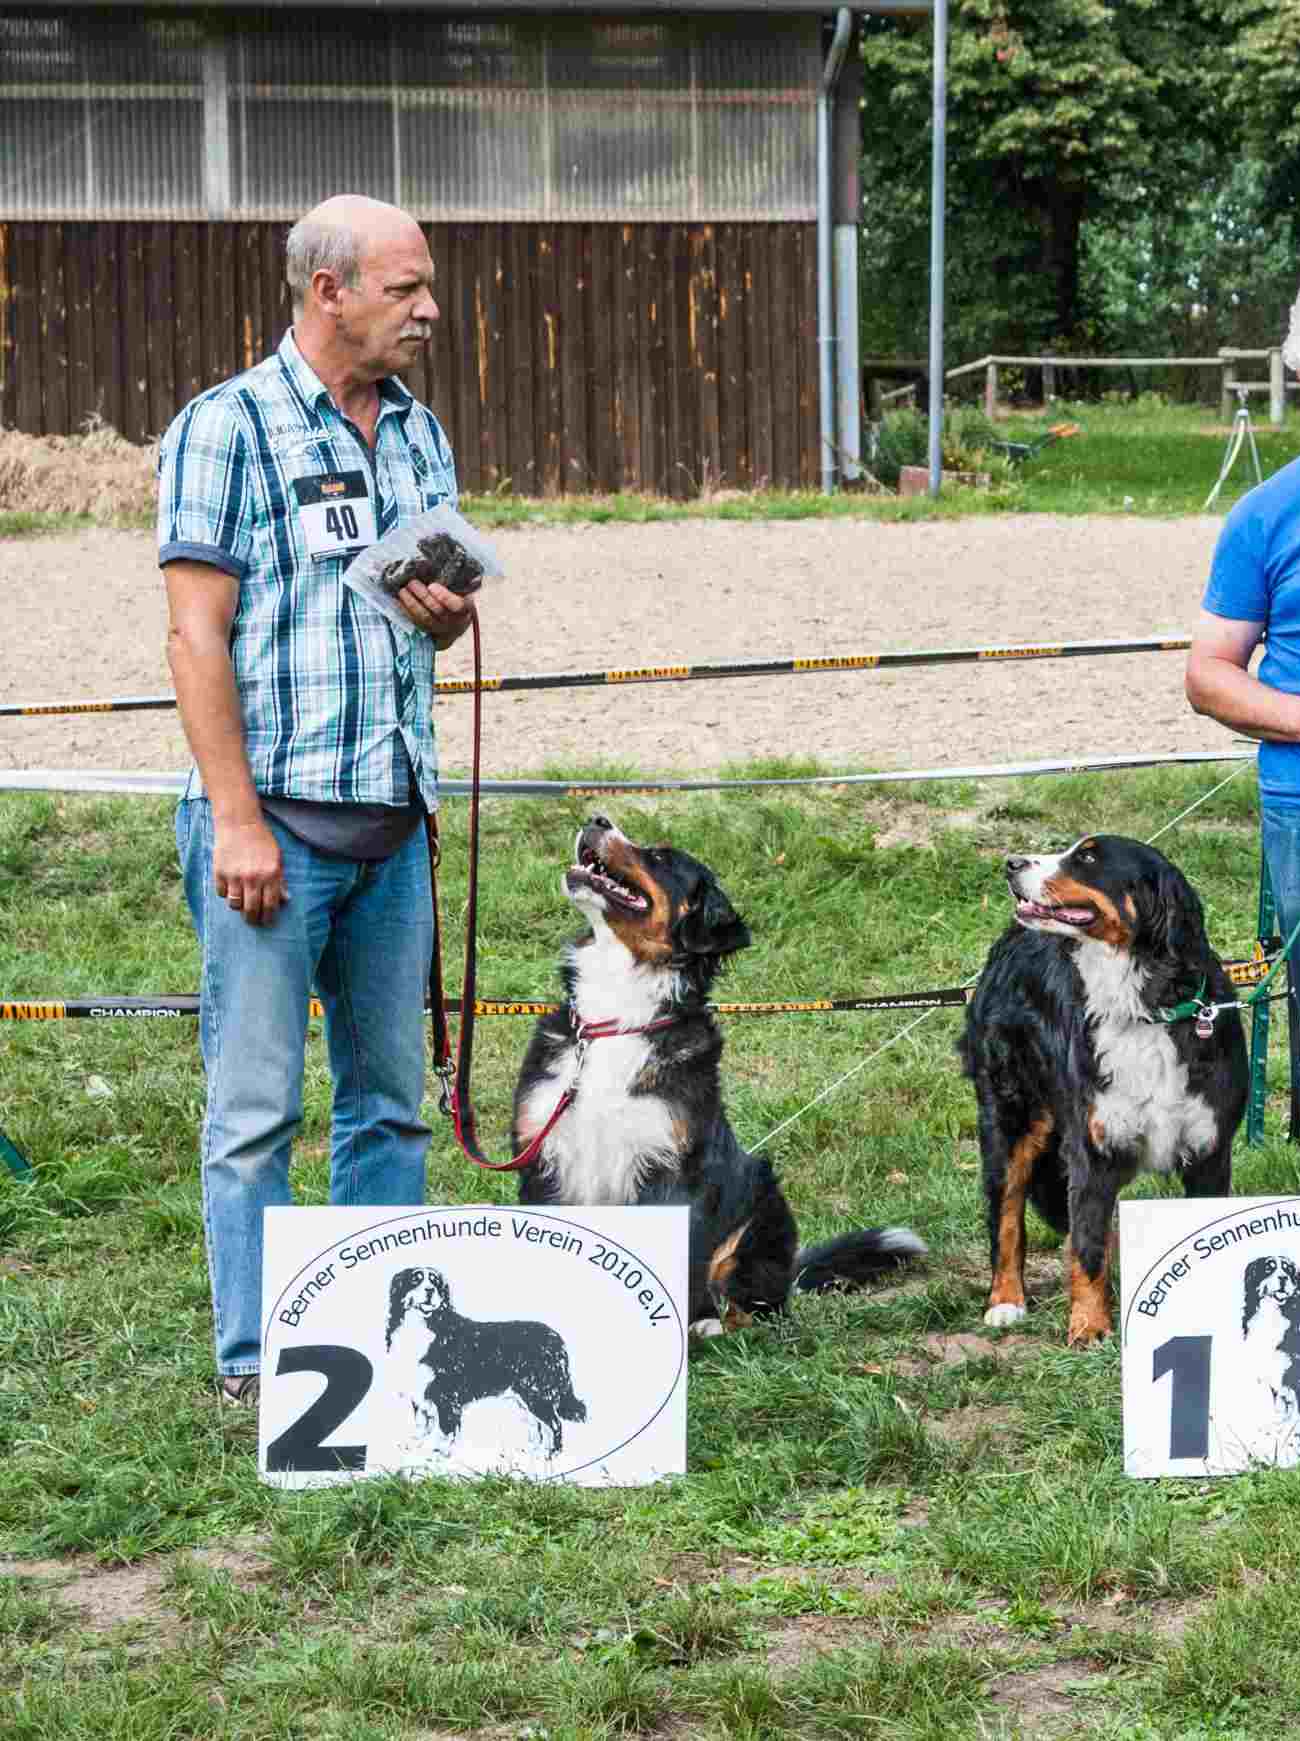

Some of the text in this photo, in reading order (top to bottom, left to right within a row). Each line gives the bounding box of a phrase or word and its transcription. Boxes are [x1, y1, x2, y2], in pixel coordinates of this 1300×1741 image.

[326, 504, 359, 541] 40
[89, 1008, 181, 1017] CHAMPION
[279, 1217, 671, 1328] Berner Sennenhunde Verein 2010 e.V.
[1137, 1252, 1193, 1319] Berner
[265, 1344, 374, 1473] 2
[1152, 1335, 1213, 1460] 1
